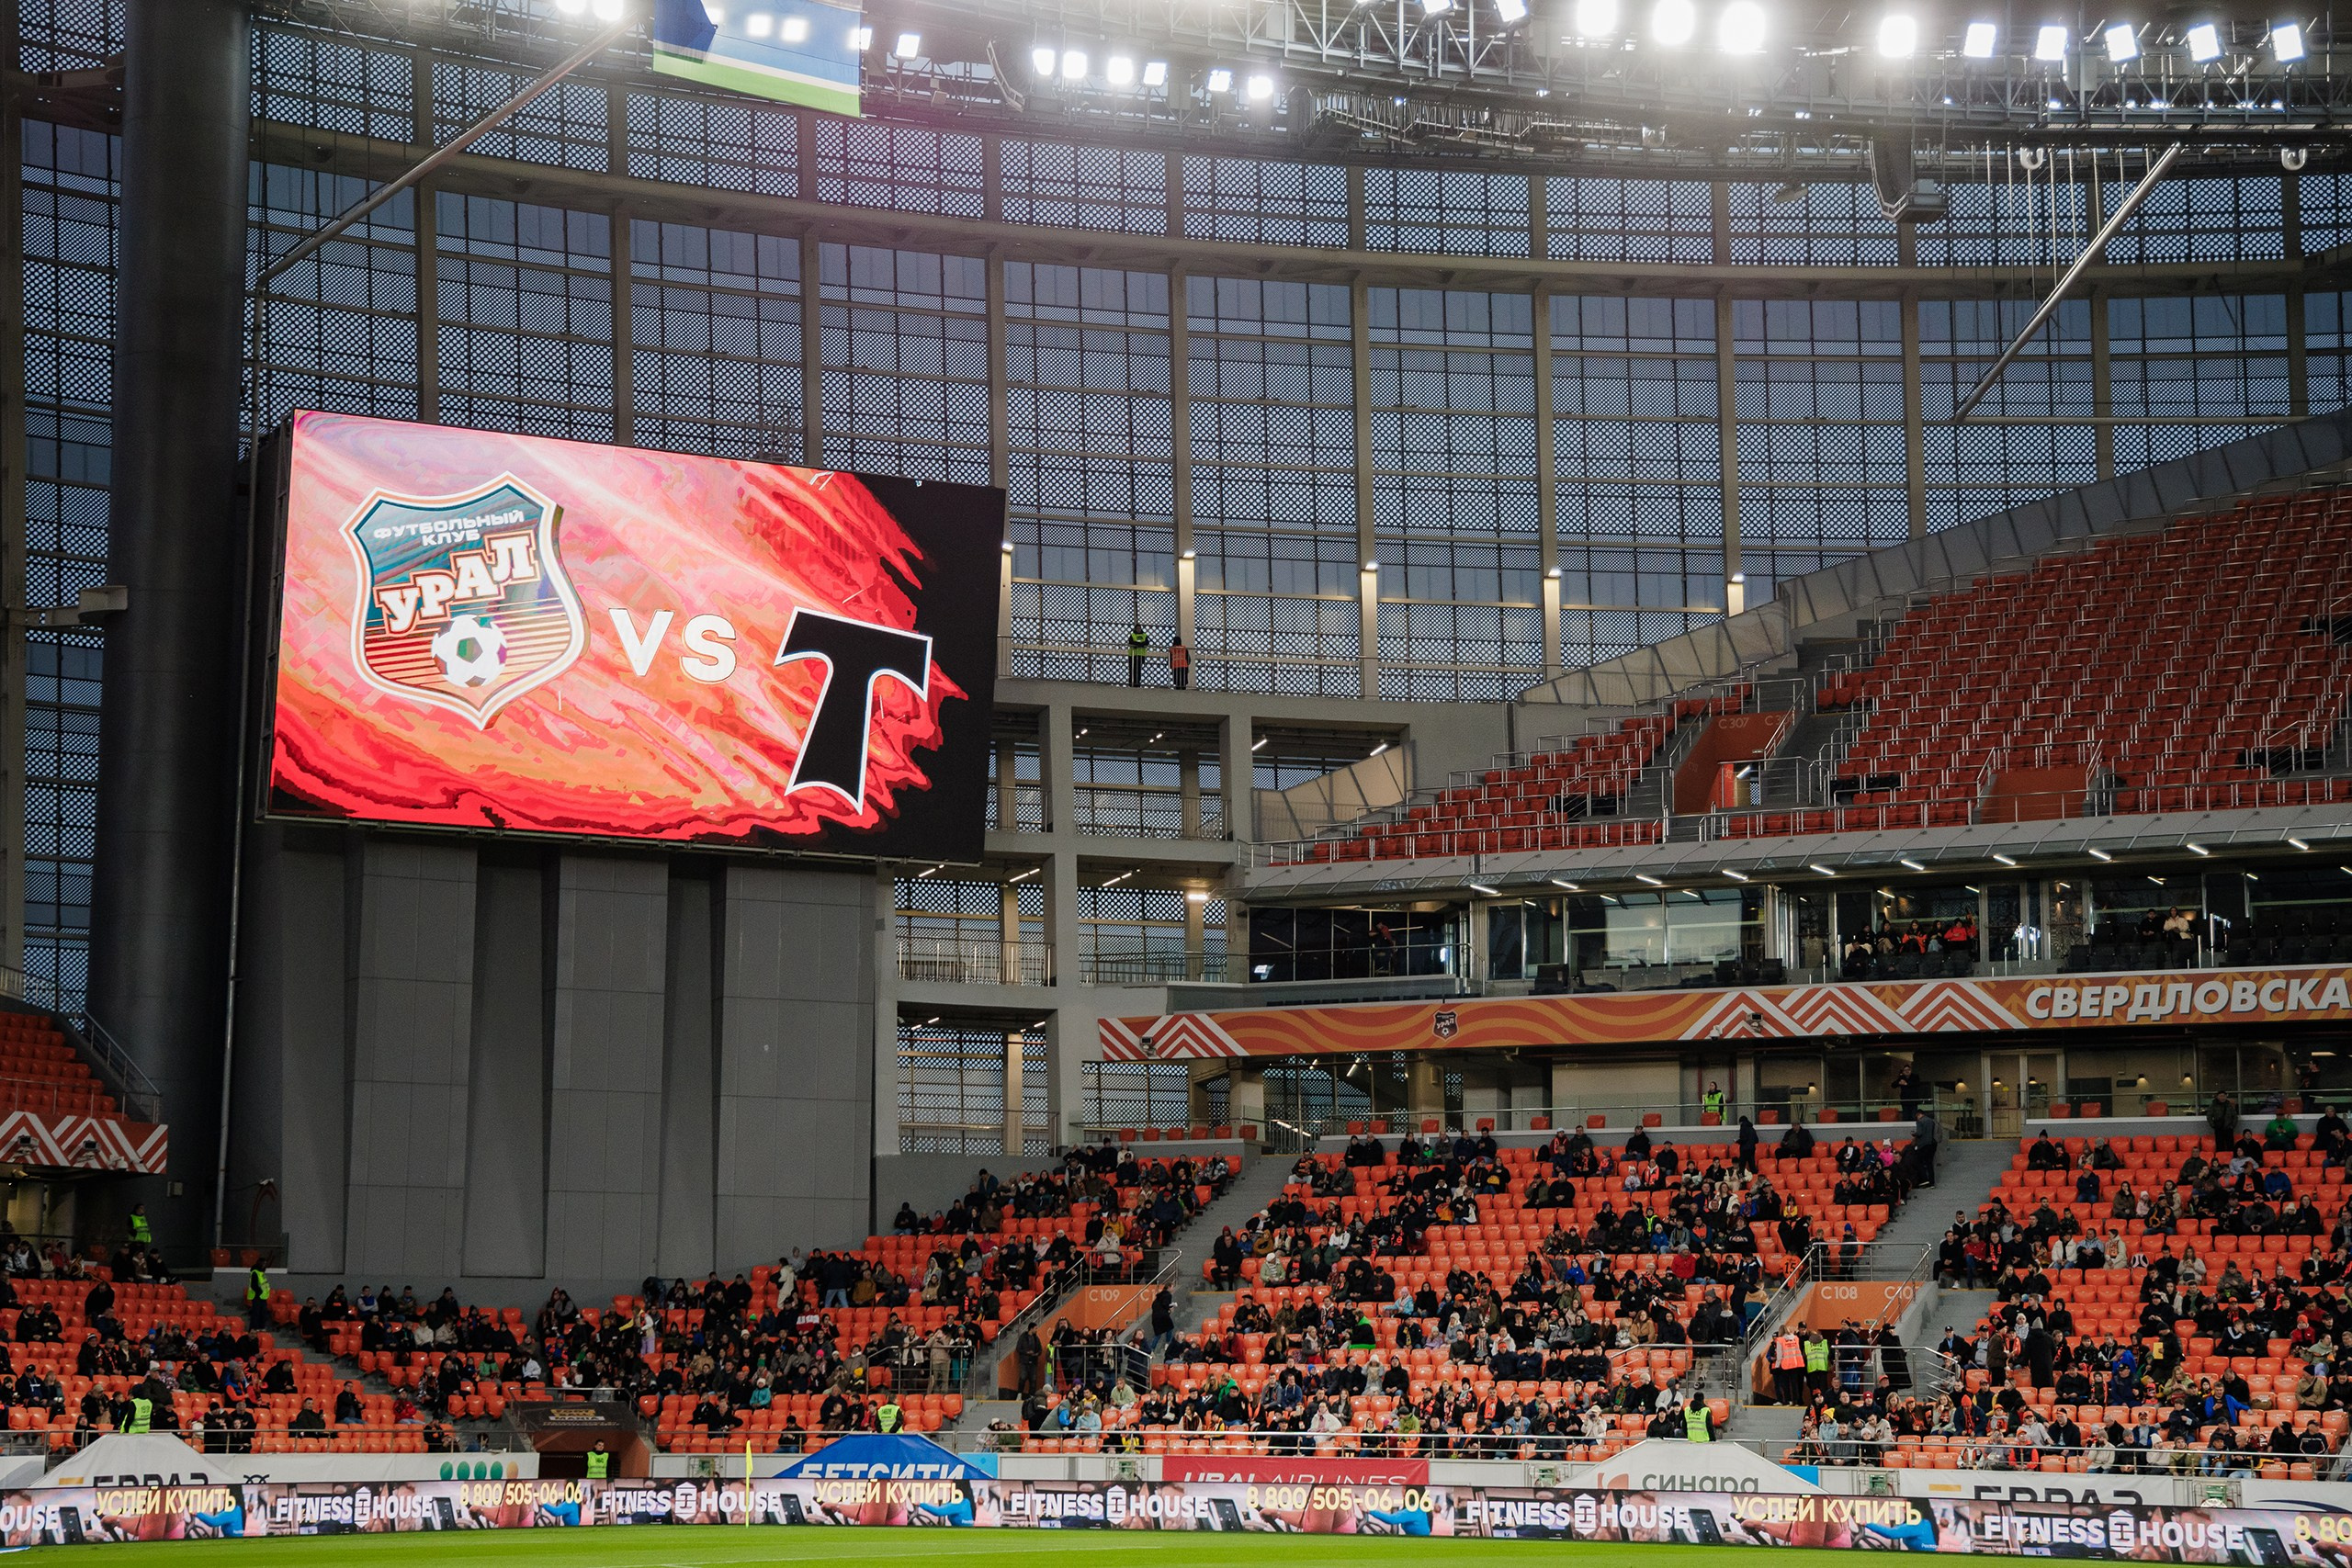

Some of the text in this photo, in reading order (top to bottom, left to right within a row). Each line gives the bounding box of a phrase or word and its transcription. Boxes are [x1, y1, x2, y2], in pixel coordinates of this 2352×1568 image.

[373, 510, 525, 539] ФУТБОЛЬНЫЙ
[423, 530, 481, 547] КЛУБ
[376, 532, 538, 634] УРАЛ
[607, 607, 737, 684] VS
[2026, 977, 2352, 1022] СВЕРДЛОВСКА
[96, 1486, 236, 1516] УСПЕЙ КУПИТЬ
[460, 1481, 582, 1506] 8 800 505-06-06
[602, 1491, 780, 1515] FITNESS HOUSE
[815, 1479, 964, 1505] УСПЕЙ КУПИТЬ
[1011, 1493, 1209, 1518] FITNESS HOUSE
[1246, 1486, 1433, 1513] 8 800 505-06-06
[277, 1495, 434, 1522] FITNESS HOUSE
[1466, 1501, 1690, 1529] FITNESS HOUSE
[1733, 1495, 1922, 1526] УСПЕЙ КУПИТЬ
[1984, 1516, 2245, 1551] FITNESS HOUSE
[2294, 1515, 2311, 1540] 8
